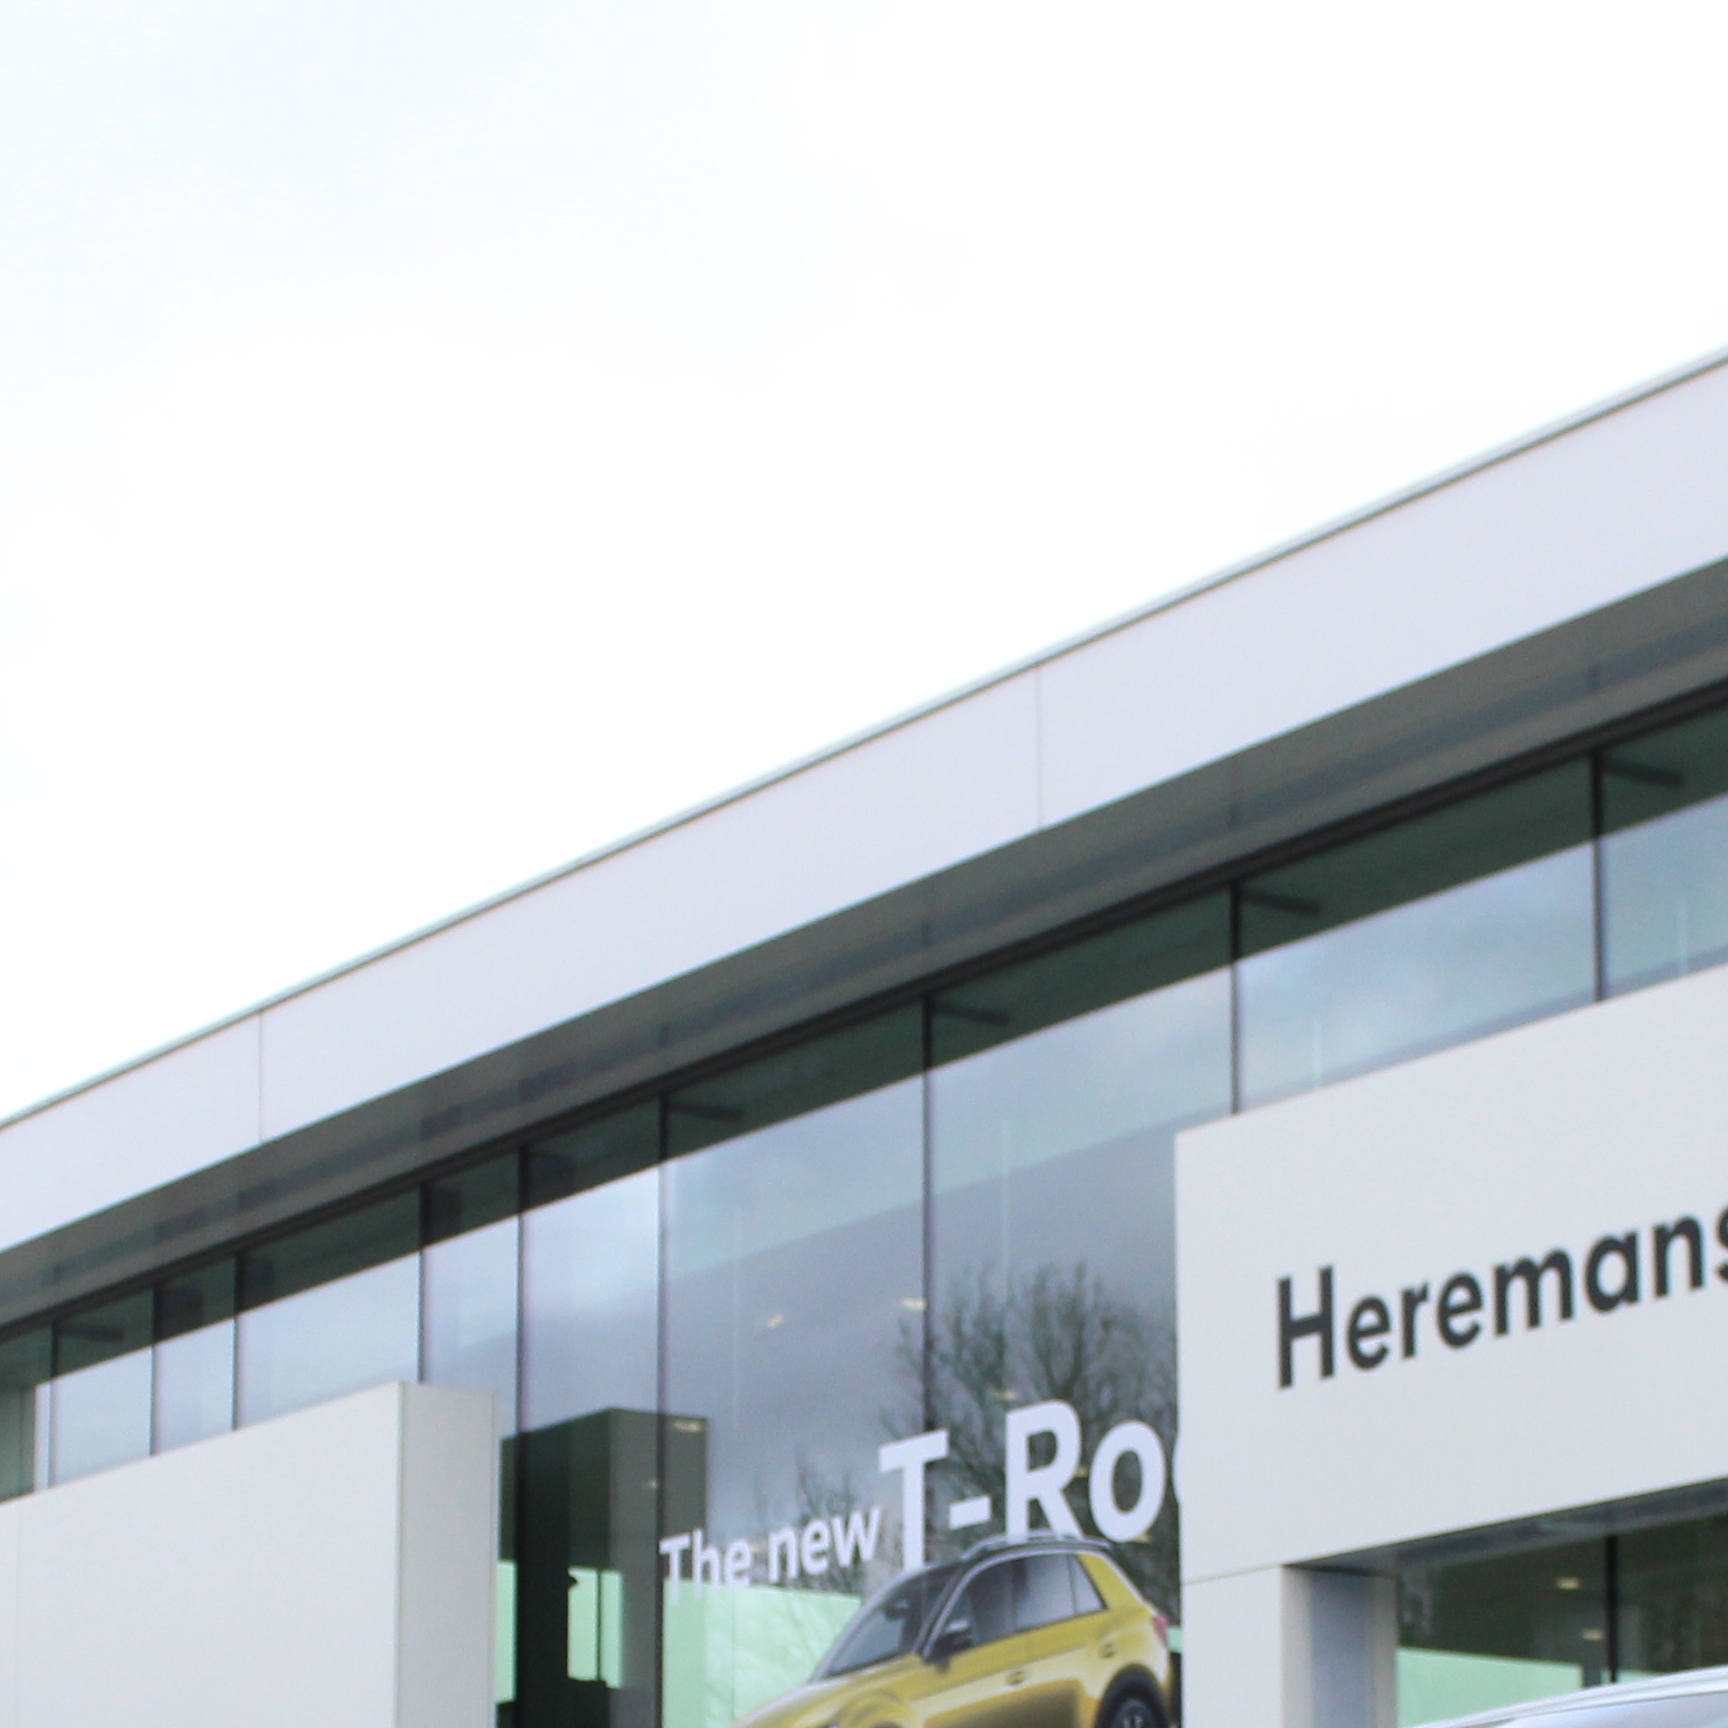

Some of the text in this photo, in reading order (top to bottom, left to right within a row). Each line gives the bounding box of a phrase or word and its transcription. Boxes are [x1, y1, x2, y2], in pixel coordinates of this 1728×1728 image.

[660, 1400, 1179, 1605] The new T-Ro
